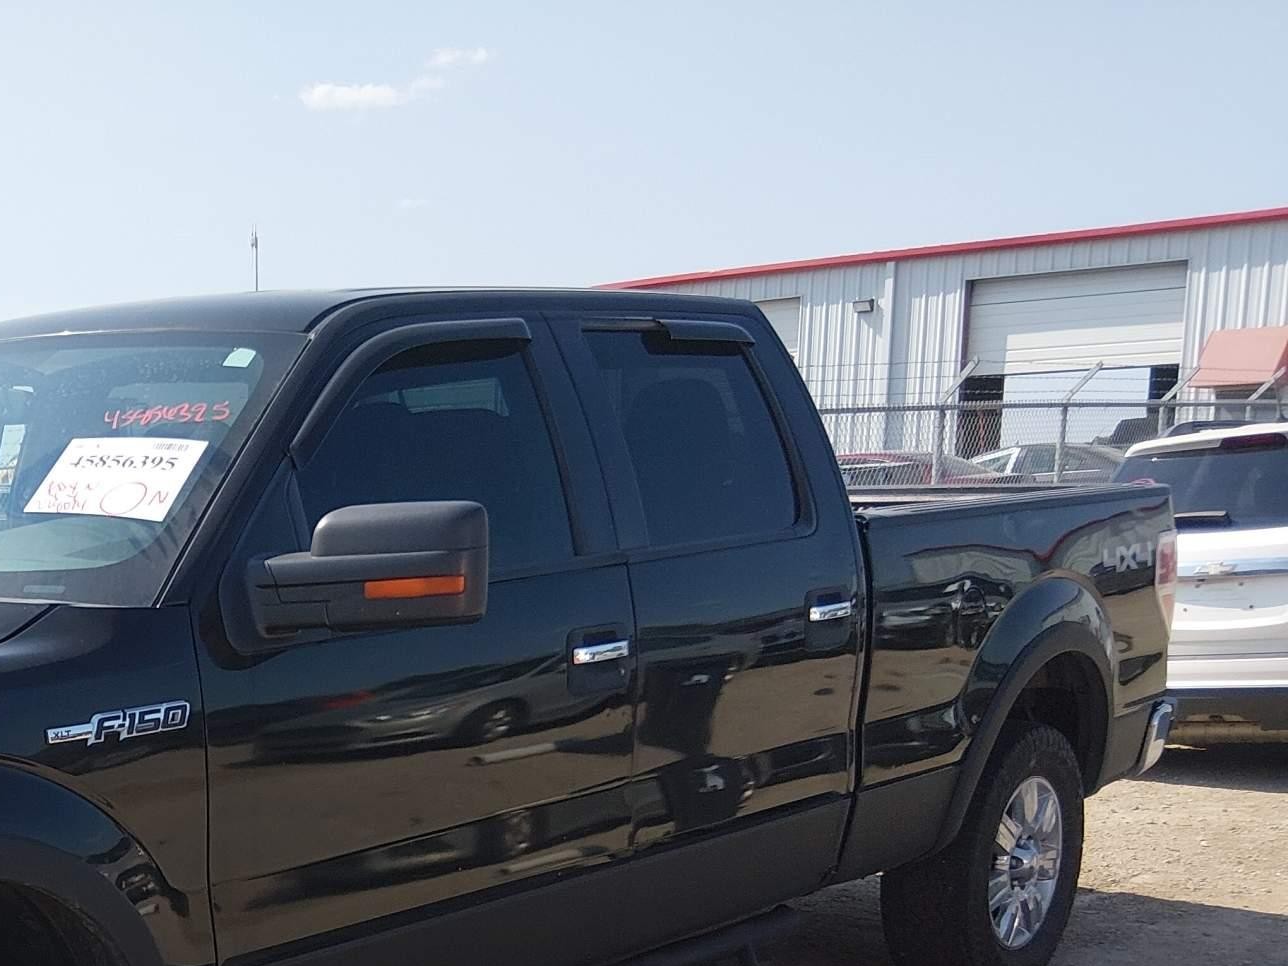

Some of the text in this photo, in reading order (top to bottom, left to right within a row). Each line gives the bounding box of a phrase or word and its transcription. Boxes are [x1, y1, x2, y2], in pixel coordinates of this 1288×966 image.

[69, 454, 180, 471] 45856395
[52, 701, 191, 745] XLT F-150
